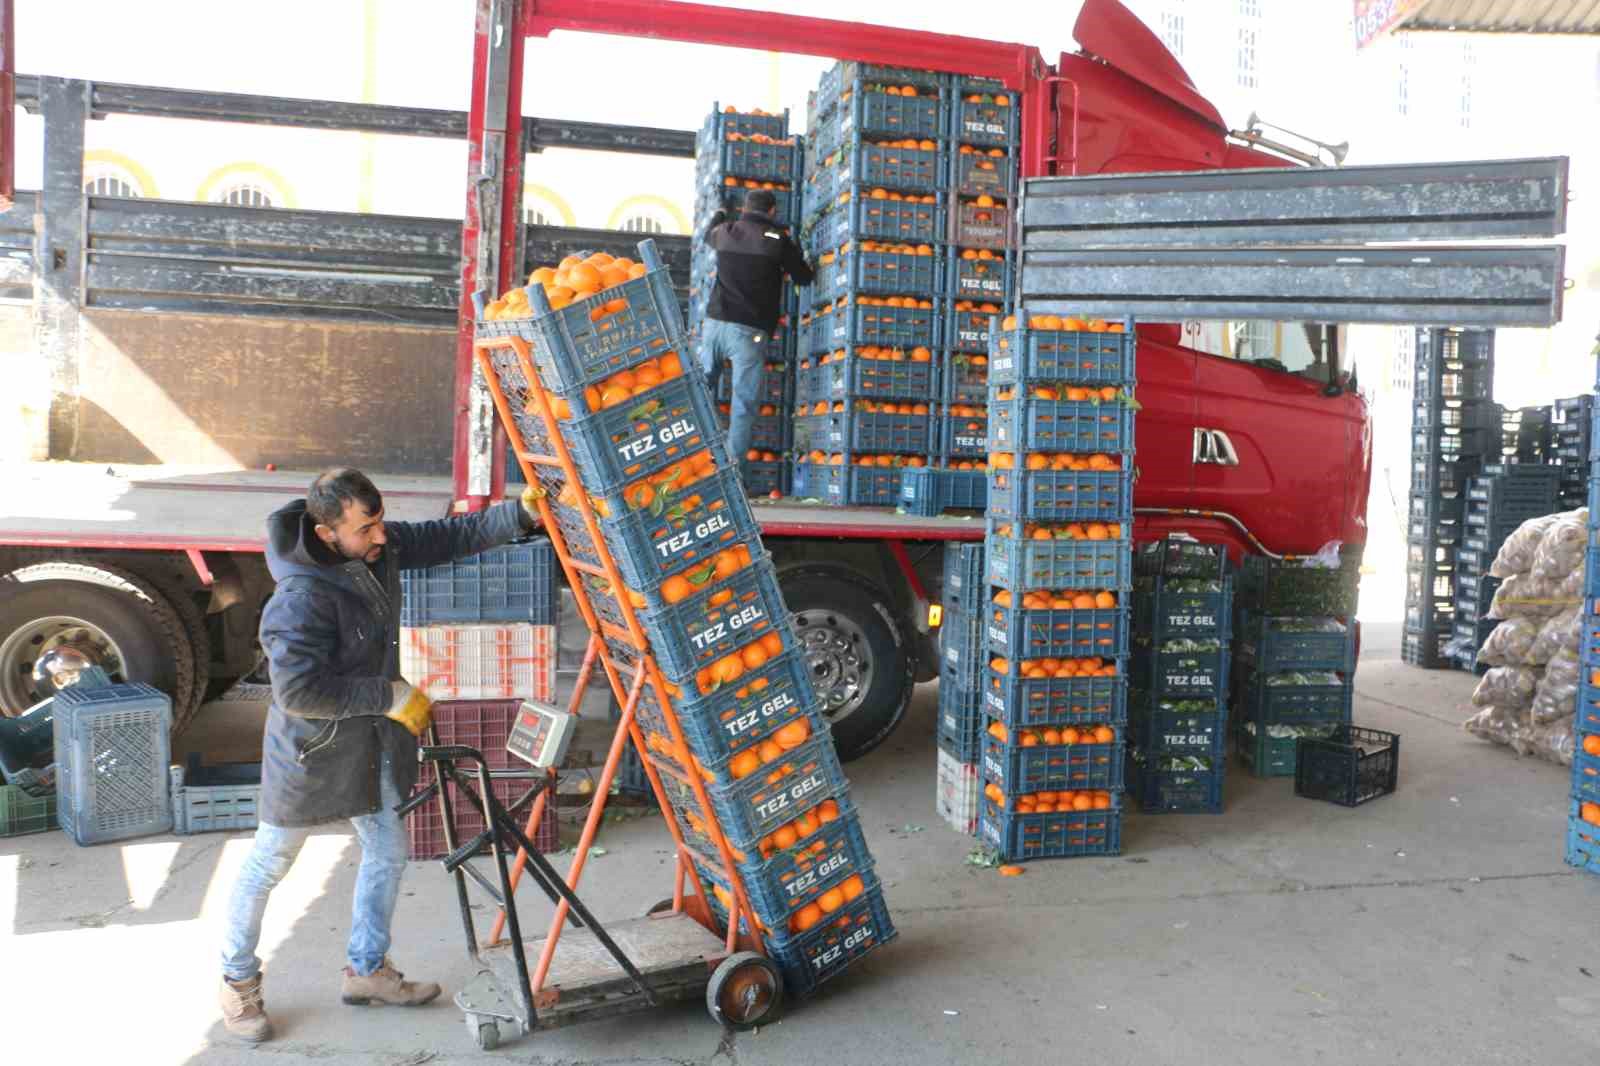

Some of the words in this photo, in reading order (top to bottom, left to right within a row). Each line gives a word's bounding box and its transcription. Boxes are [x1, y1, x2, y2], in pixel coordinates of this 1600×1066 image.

[965, 121, 985, 131] TEZ
[986, 124, 1006, 134] GEL
[961, 279, 980, 288] TEZ
[960, 331, 979, 340] TEZ
[618, 434, 656, 461] TEZ
[659, 419, 695, 443] GEL
[955, 437, 975, 447] TEZ
[656, 531, 693, 557] TEZ
[695, 515, 730, 538] GEL
[691, 623, 727, 649] TEZ
[730, 605, 763, 629] GEL
[1168, 615, 1191, 626] TEZ
[1193, 616, 1216, 626] GEL
[1166, 675, 1189, 686] TEZ
[1191, 675, 1213, 686] GEL
[725, 710, 759, 736] TEZ
[762, 692, 794, 716] GEL
[1164, 735, 1186, 745] TEZ
[1188, 735, 1211, 745] GEL
[757, 793, 789, 819] TEZ
[791, 775, 822, 798] GEL
[785, 871, 817, 896] TEZ
[819, 853, 848, 876] GEL
[812, 945, 842, 969] TEZ
[844, 926, 873, 949] GEL
